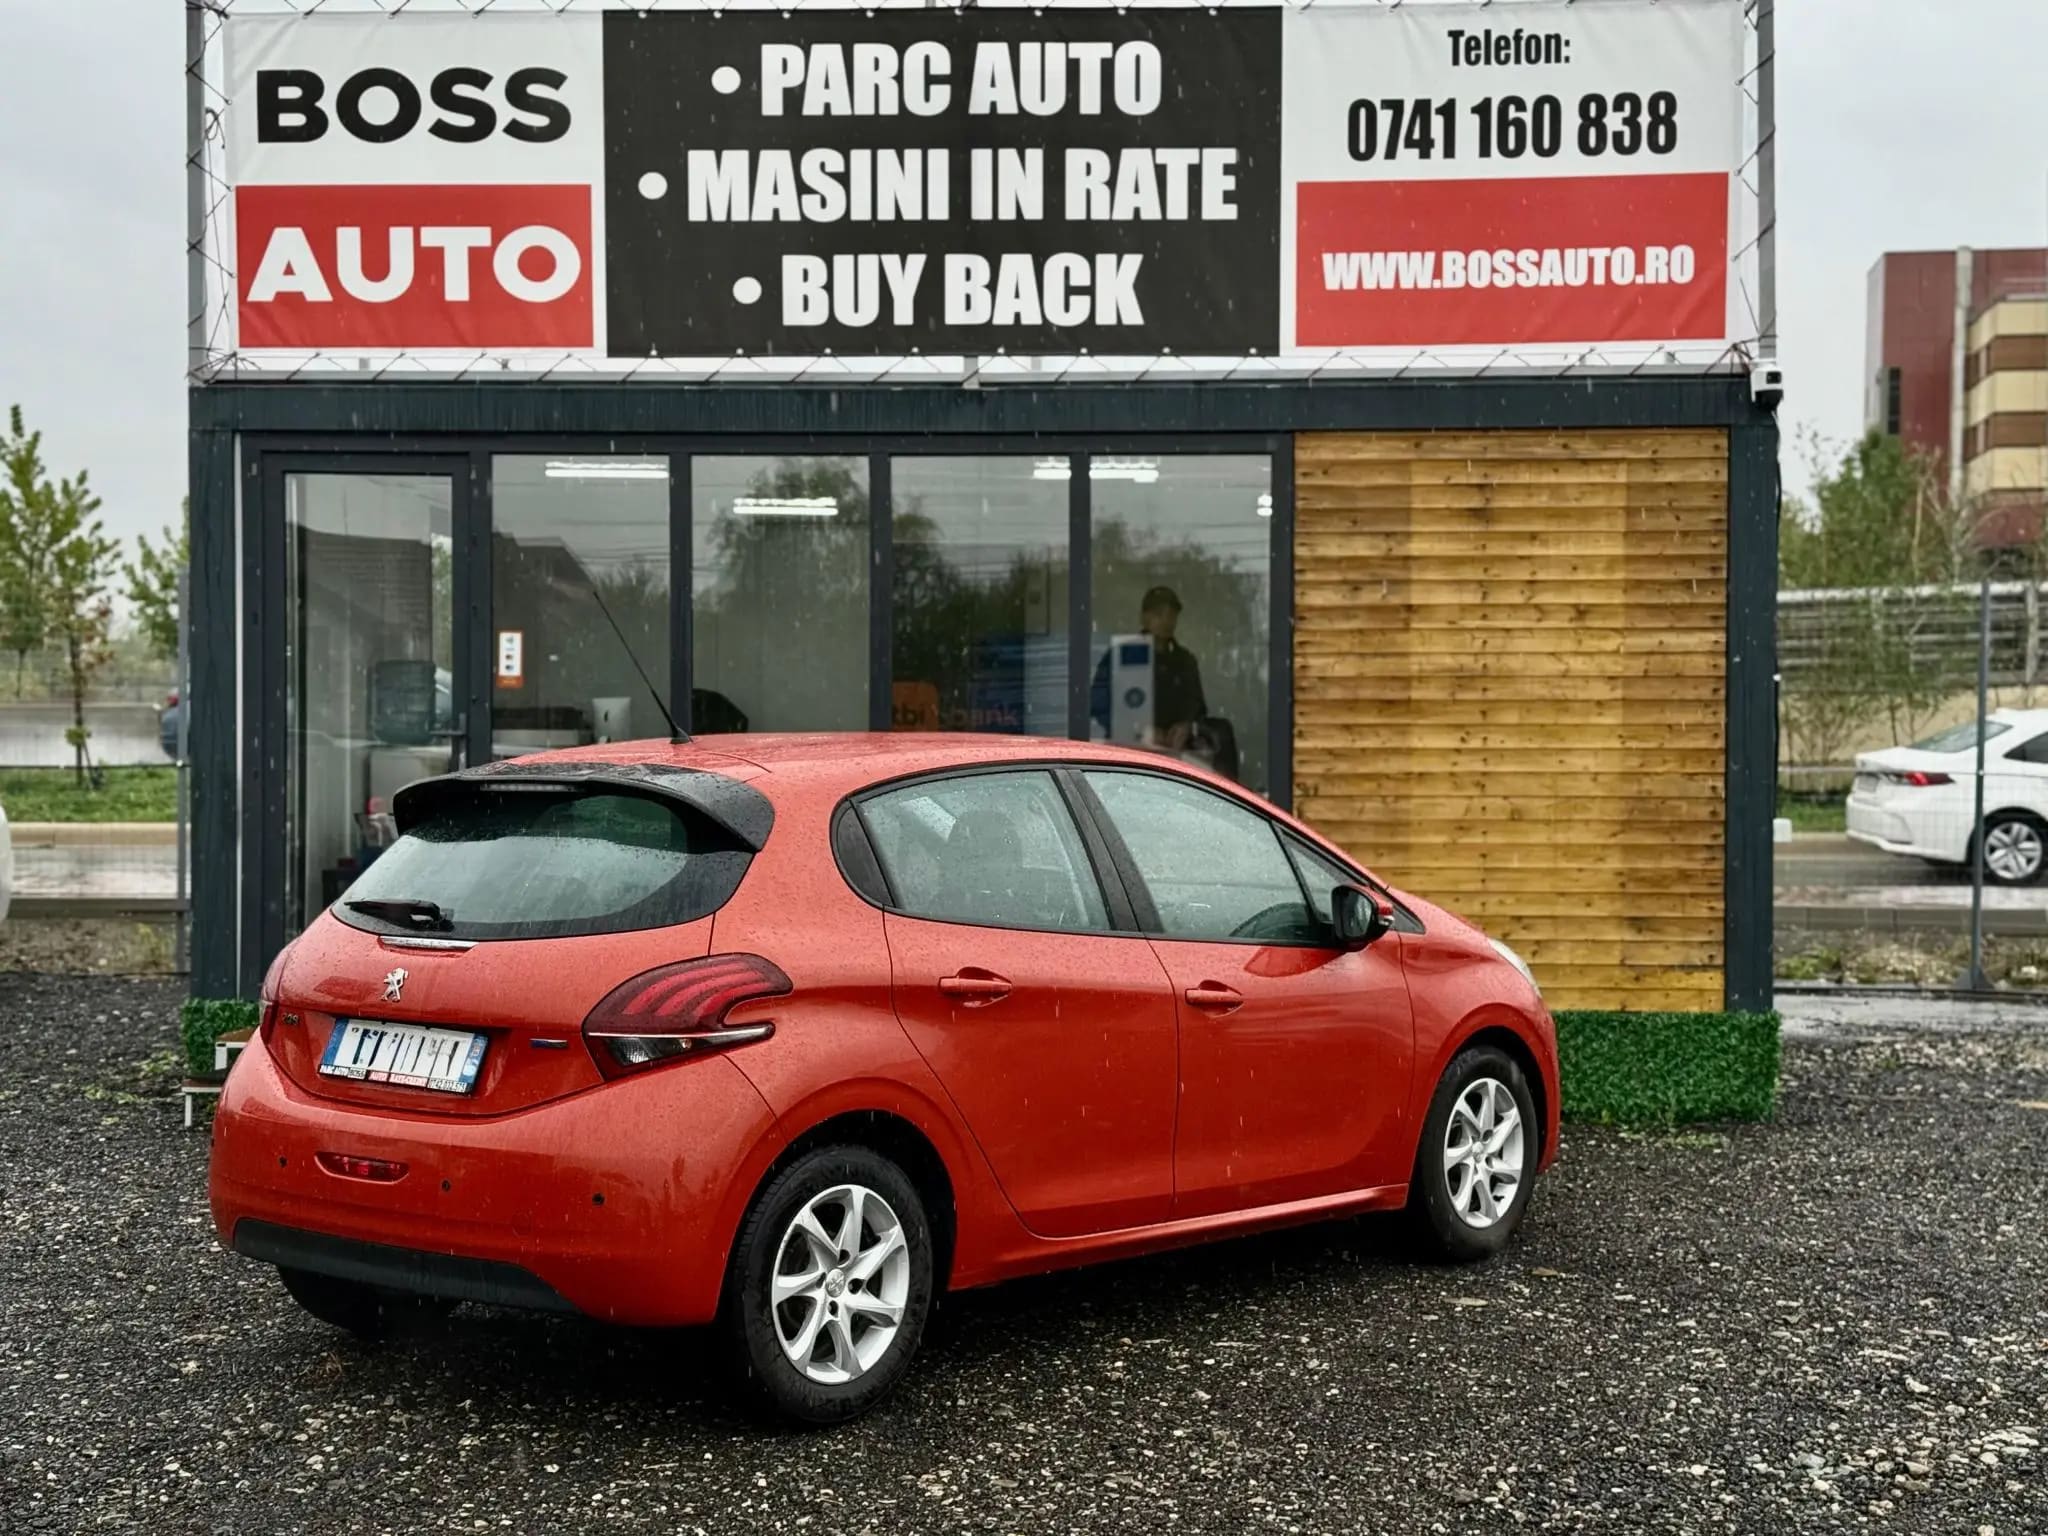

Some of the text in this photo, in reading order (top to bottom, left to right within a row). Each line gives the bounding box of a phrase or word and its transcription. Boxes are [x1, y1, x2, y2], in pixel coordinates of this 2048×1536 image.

[762, 40, 1162, 116] PARC AUTO
[1448, 29, 1571, 66] Telefon:
[256, 67, 571, 144] BOSS
[1348, 91, 1677, 162] 0741 160 838
[687, 147, 1238, 223] MASINI IN RATE
[247, 225, 582, 303] AUTO
[781, 252, 1145, 327] BUY BACK
[1322, 244, 1695, 291] WWW.BOSSAUTO.RO
